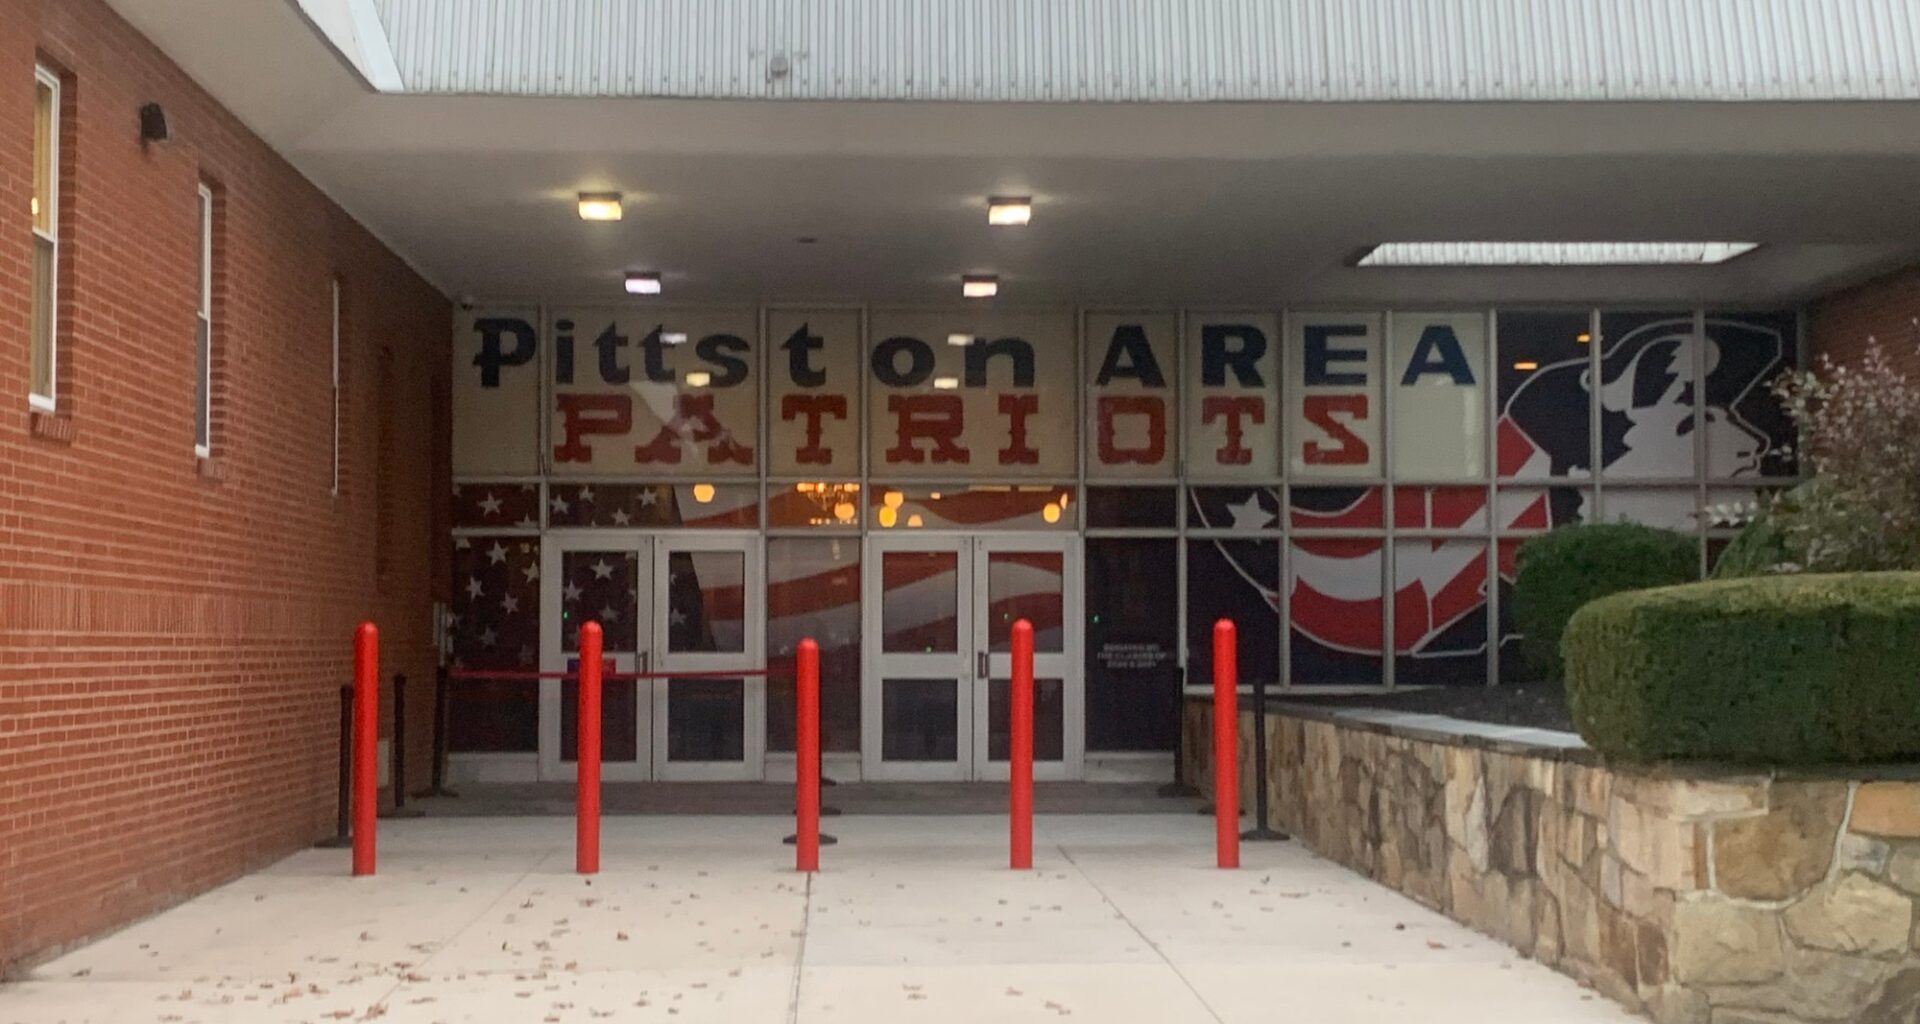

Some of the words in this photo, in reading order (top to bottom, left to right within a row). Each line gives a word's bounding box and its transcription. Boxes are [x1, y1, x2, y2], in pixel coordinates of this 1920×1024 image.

[473, 318, 1035, 388] Pittston
[1095, 325, 1476, 388] AREA
[553, 394, 1369, 465] PATRIOTS
